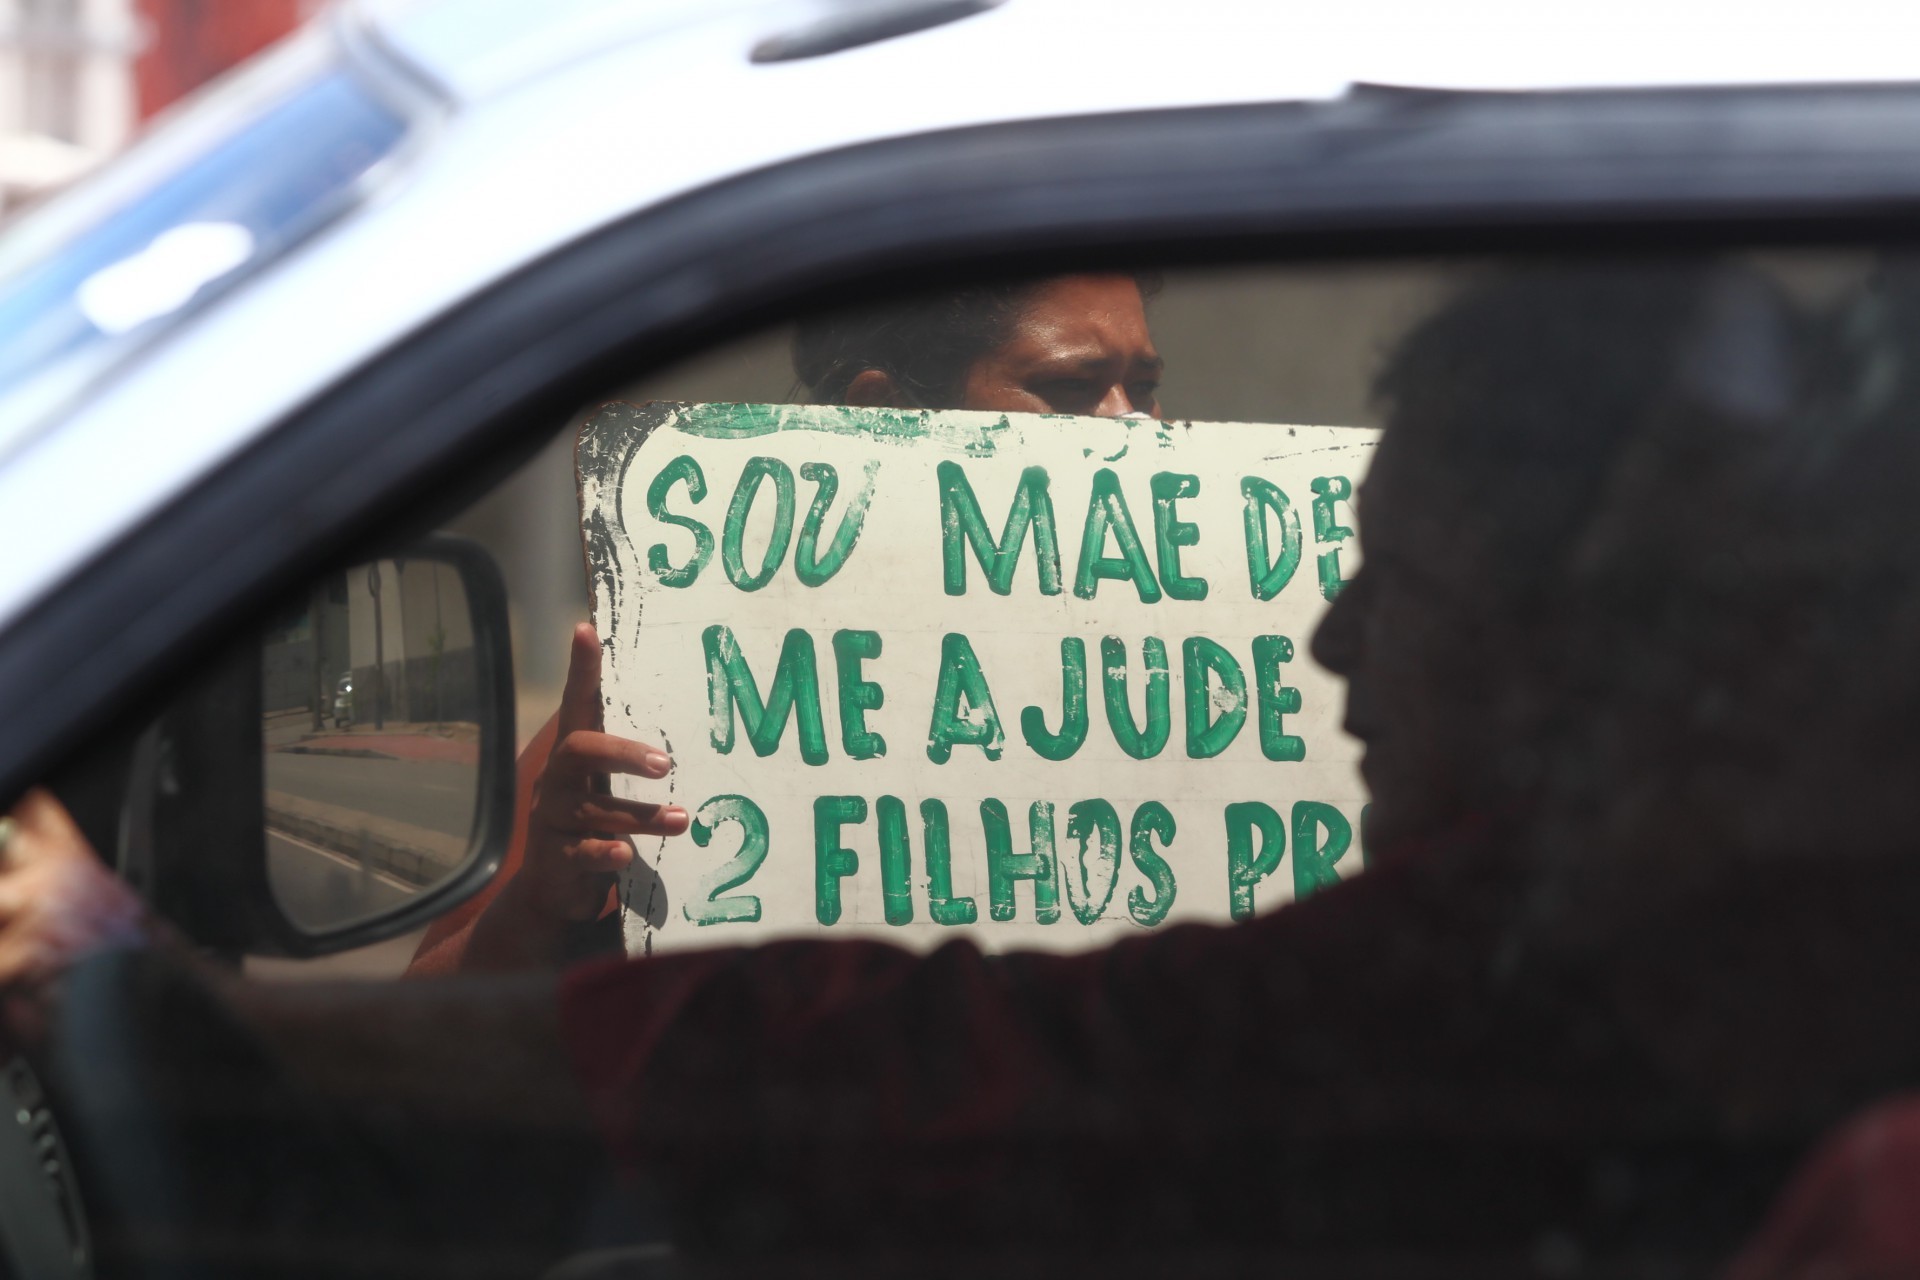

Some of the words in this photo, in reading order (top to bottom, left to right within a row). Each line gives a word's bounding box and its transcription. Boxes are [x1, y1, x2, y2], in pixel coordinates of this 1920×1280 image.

[646, 454, 881, 592] SOU
[1240, 475, 1354, 601] DE
[702, 624, 886, 766] ME
[684, 794, 770, 925] 2
[814, 796, 1177, 927] FILHOS
[1224, 801, 1371, 922] PR
